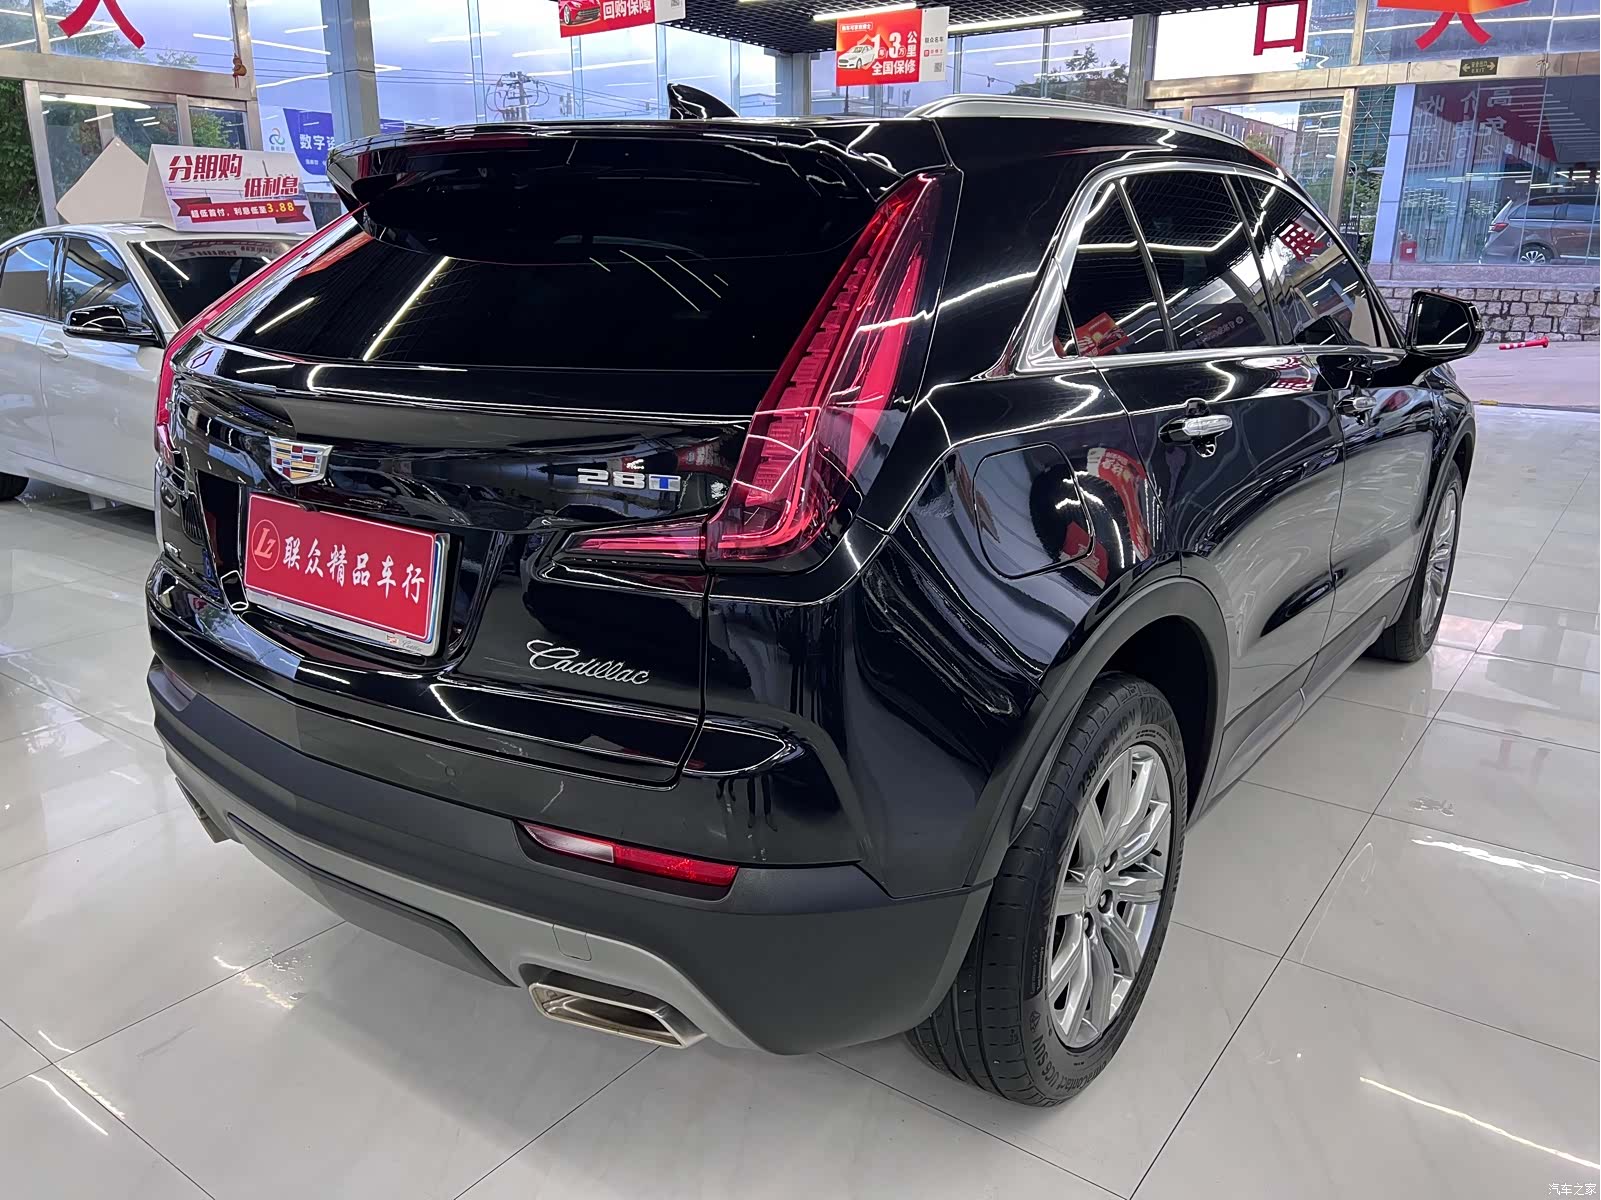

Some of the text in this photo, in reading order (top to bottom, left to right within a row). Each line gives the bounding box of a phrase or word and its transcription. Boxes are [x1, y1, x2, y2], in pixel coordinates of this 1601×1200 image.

[603, 0, 651, 20] 回购保障
[872, 60, 916, 76] 全国保修
[168, 154, 243, 182] 分期购
[243, 176, 299, 198] 低利息
[577, 467, 682, 492] 28T
[282, 535, 426, 604] 联众精品车行
[526, 639, 650, 685] Cadillac
